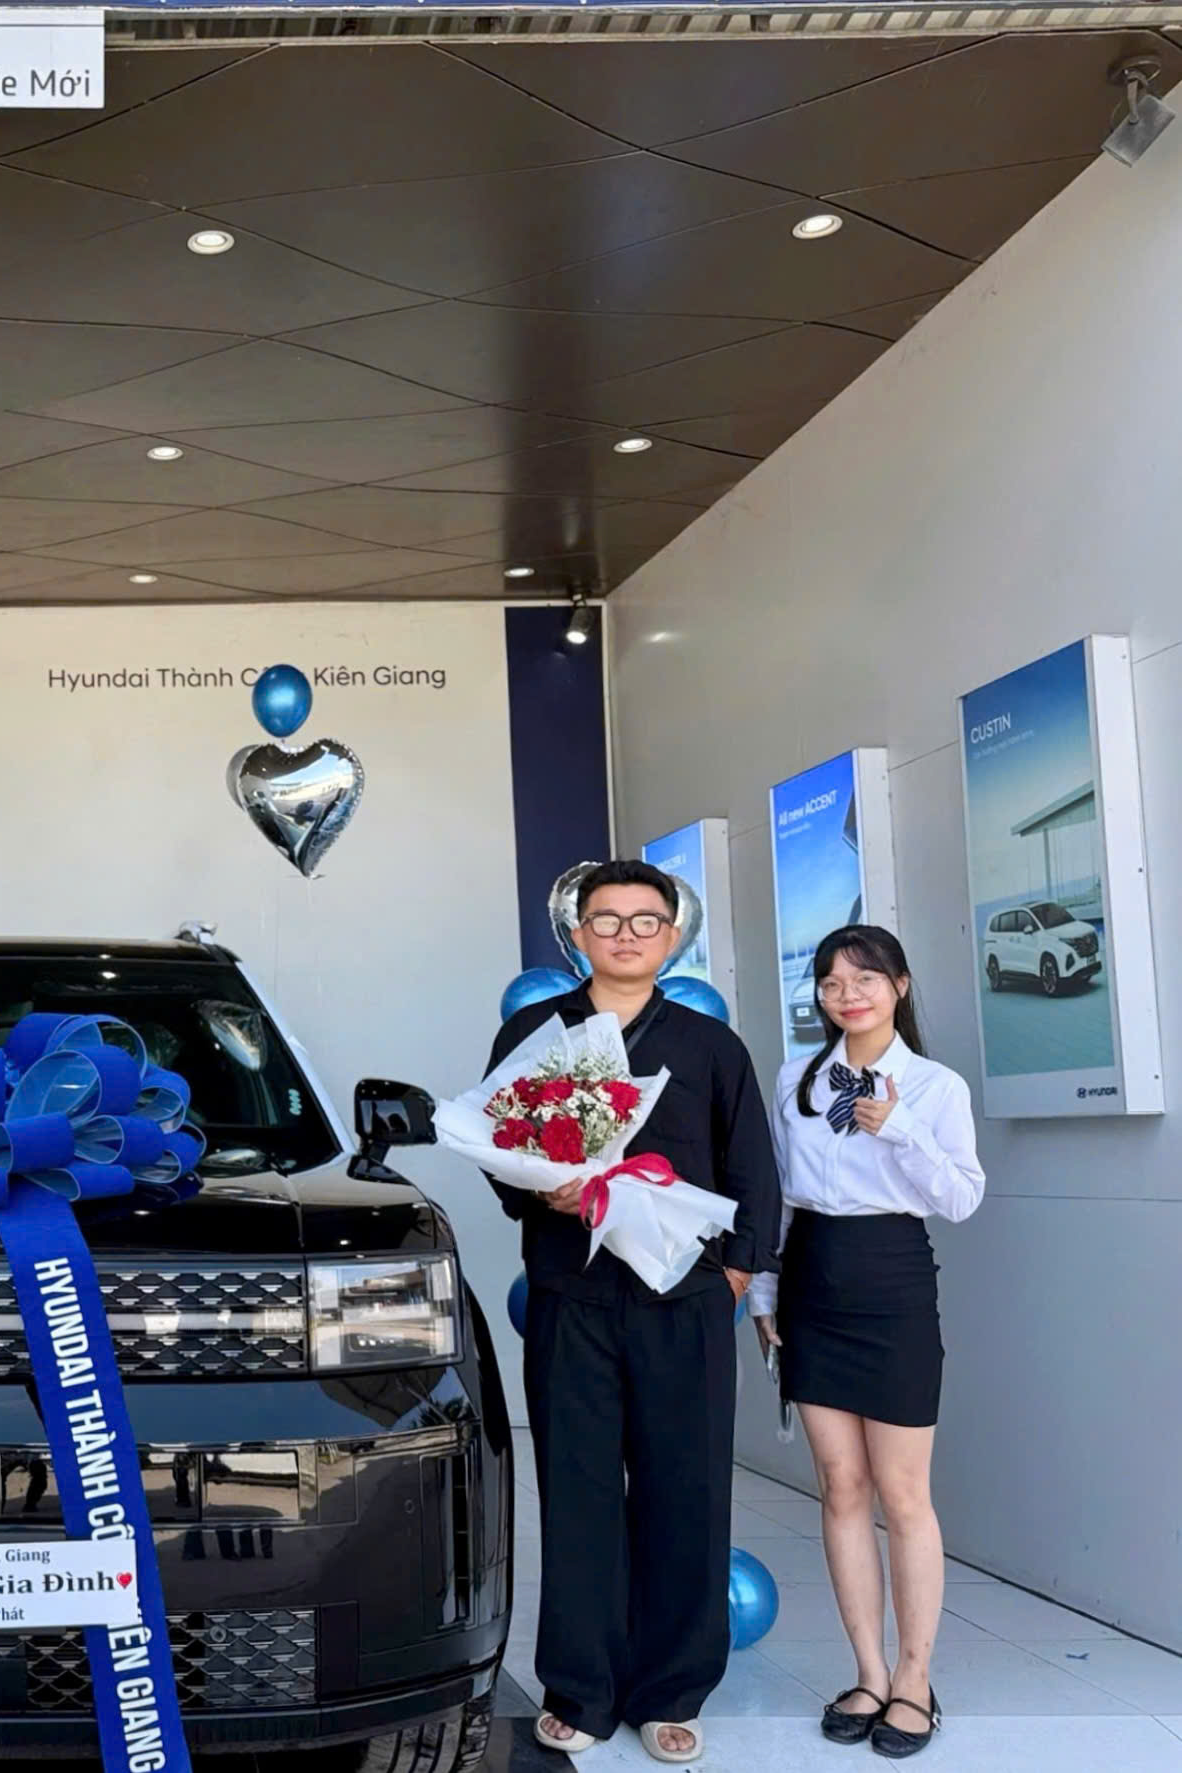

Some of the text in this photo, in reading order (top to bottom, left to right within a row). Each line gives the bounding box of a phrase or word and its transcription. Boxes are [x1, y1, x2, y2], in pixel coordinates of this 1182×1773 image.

[30, 69, 91, 97] Mới
[48, 667, 150, 693] Hyundai
[156, 667, 234, 688] Thành
[314, 665, 446, 689] Kiên Giang
[970, 711, 1011, 744] CUSTIN
[34, 1257, 97, 1388] HYUNDAI
[66, 1389, 120, 1501] THÀNH
[5, 1548, 51, 1565] Giang
[42, 1570, 116, 1593] Đình
[116, 1676, 167, 1773] GIANG
